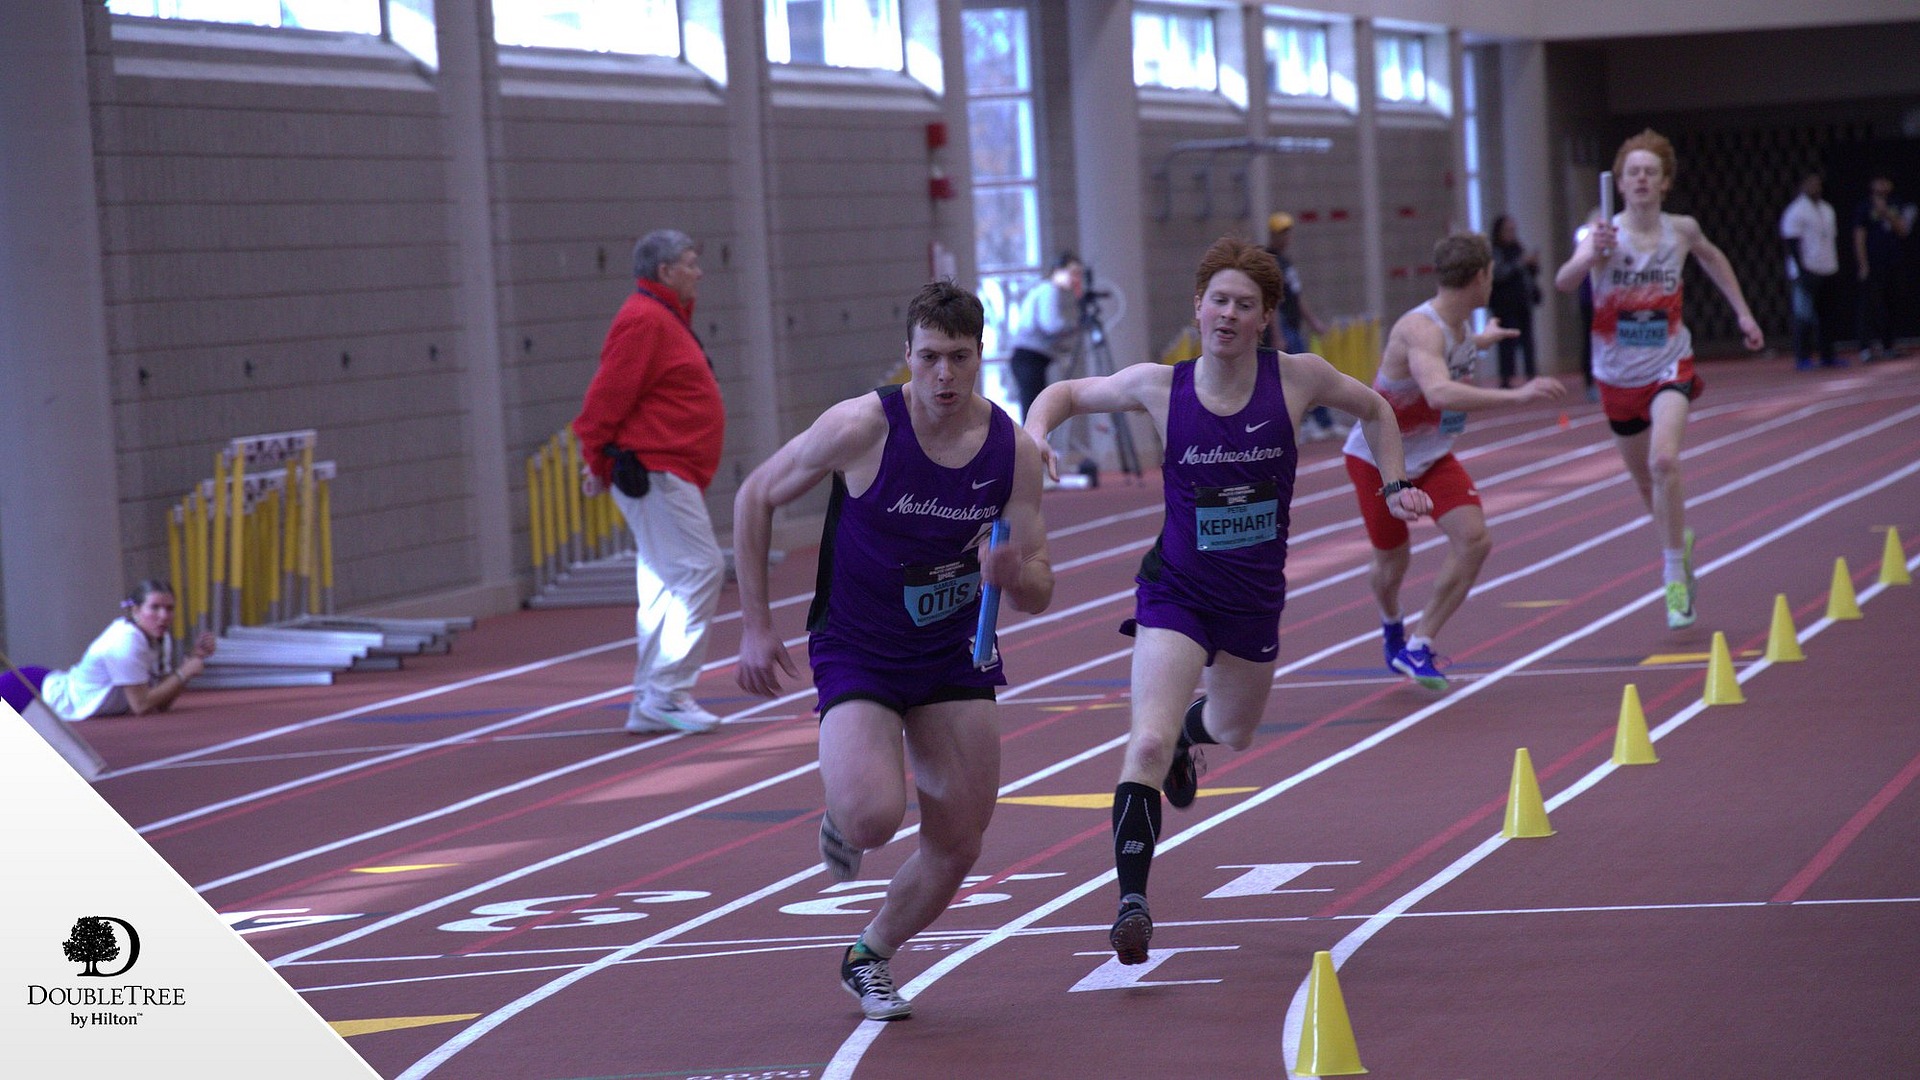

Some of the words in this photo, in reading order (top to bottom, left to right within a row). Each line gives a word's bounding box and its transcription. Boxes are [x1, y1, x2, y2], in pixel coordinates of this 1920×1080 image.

[1178, 444, 1283, 465] Northwestern
[886, 492, 999, 521] Northwestern
[1227, 505, 1248, 514] PETER
[1199, 511, 1275, 536] KEPHART
[933, 580, 958, 592] SAMUEL
[917, 582, 971, 616] OTIS
